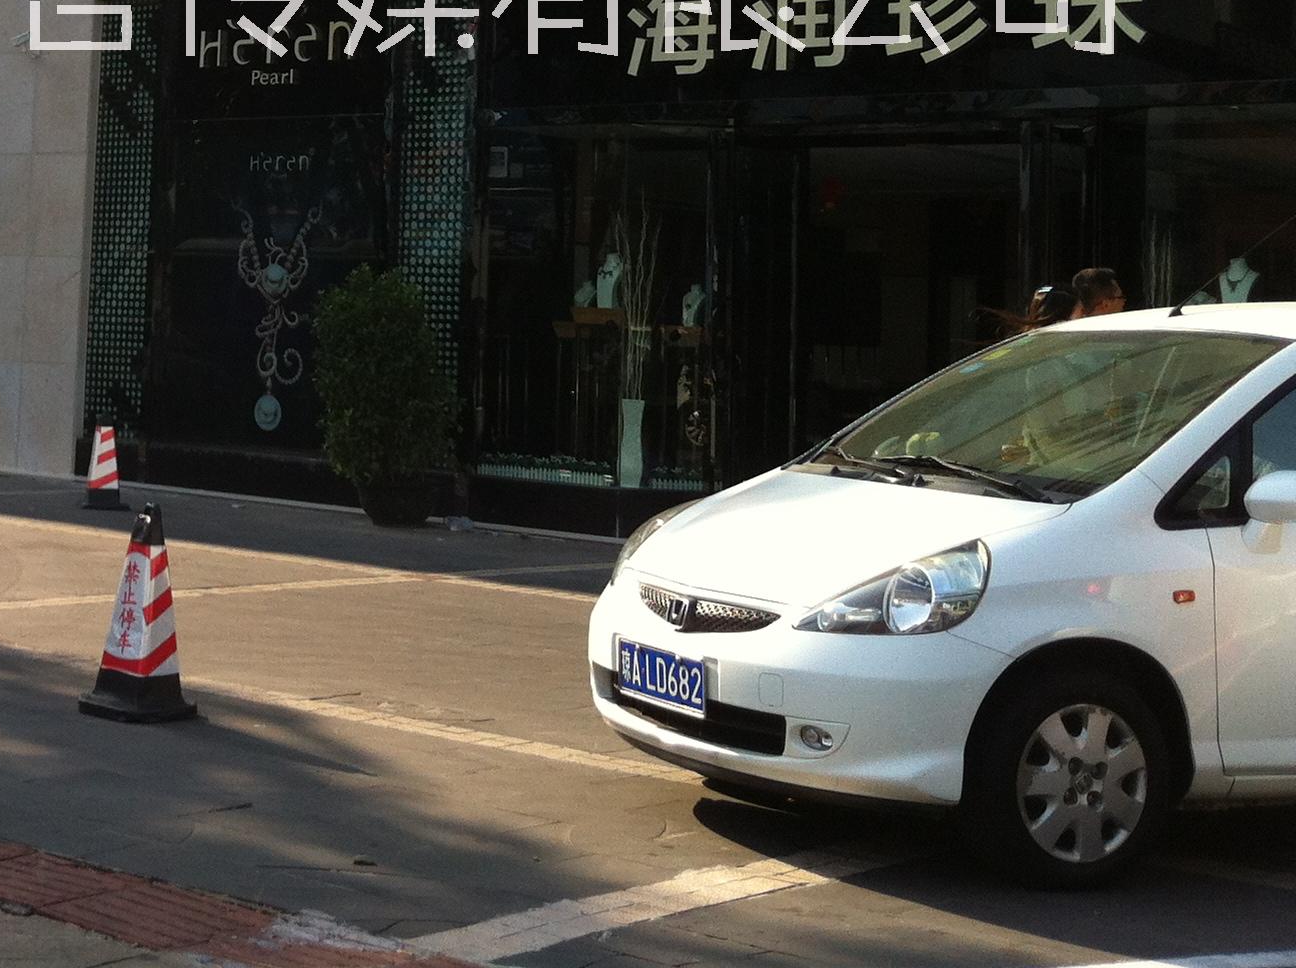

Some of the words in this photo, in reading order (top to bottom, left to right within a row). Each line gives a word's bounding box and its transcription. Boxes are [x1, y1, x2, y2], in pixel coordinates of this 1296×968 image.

[251, 68, 295, 86] Pearl
[117, 560, 141, 656] 禁止停车
